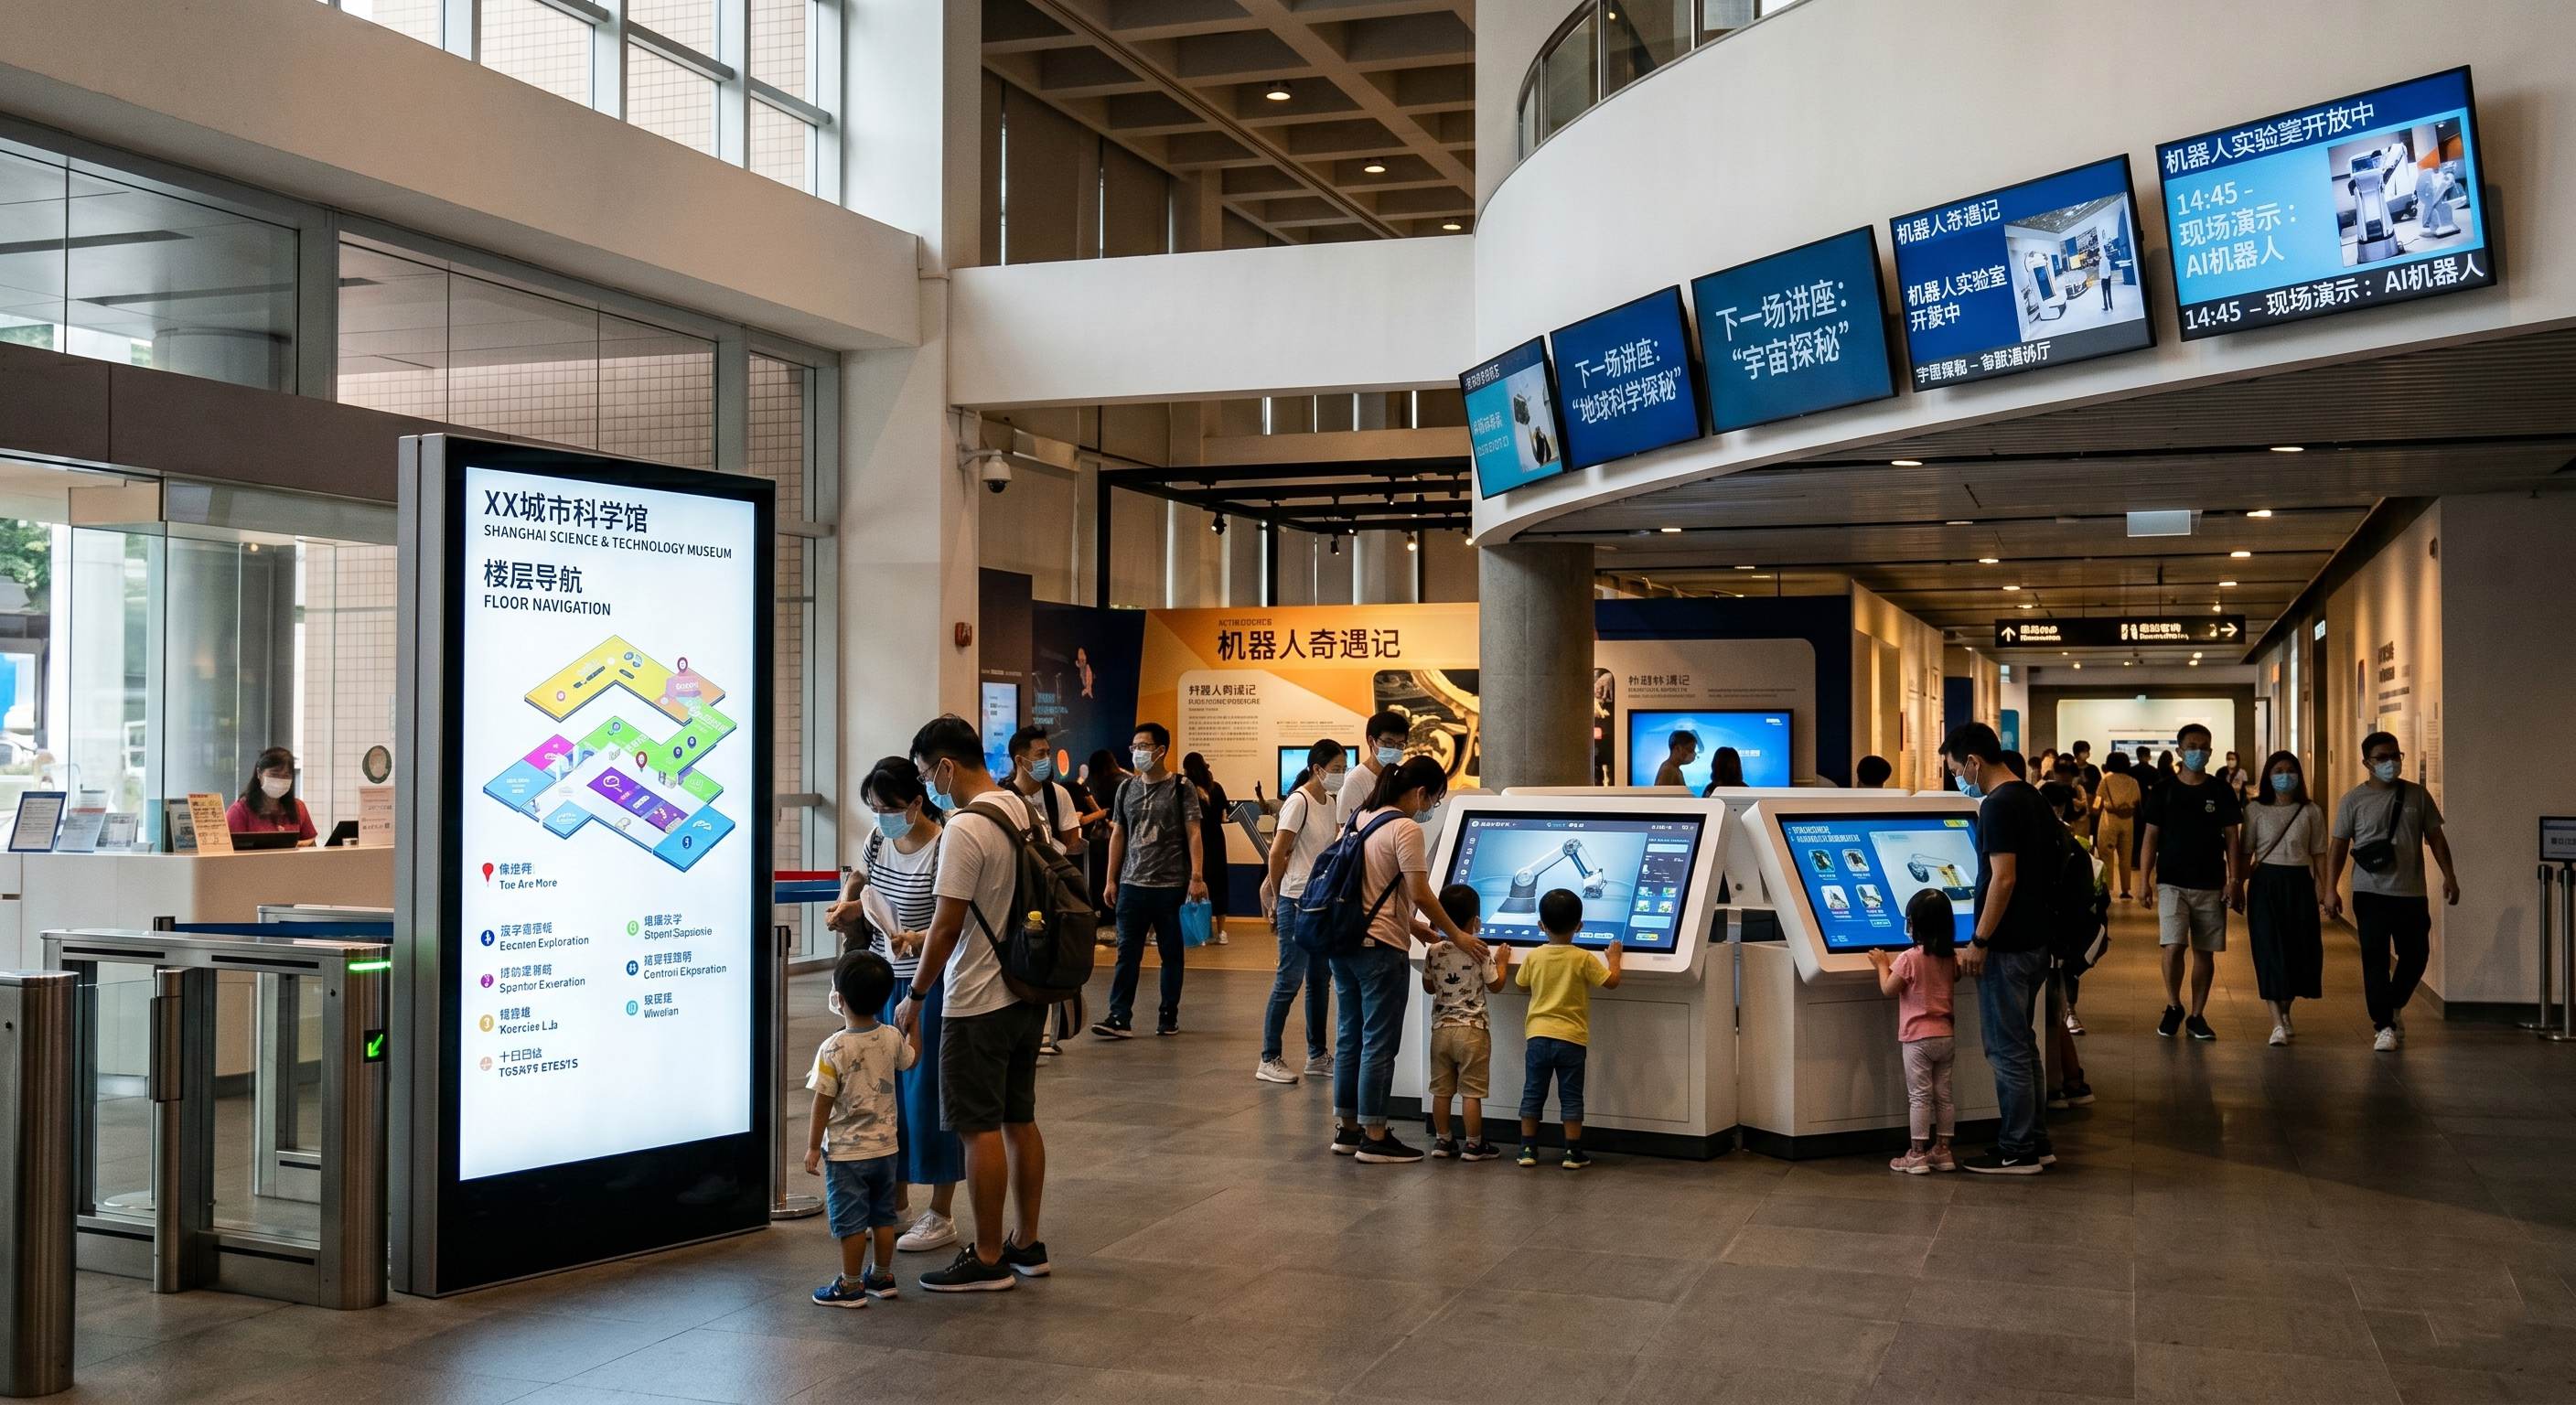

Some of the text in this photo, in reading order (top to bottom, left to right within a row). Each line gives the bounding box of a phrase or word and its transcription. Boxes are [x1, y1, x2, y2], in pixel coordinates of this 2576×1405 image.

[2177, 181, 2238, 216] 14:45
[2179, 202, 2297, 247] 现场演示：
[2186, 235, 2284, 279] AI机器人
[1907, 264, 2008, 306] 机器人实验室
[1715, 279, 1847, 342] 下一场讲座：
[2185, 301, 2242, 330] 14:45
[1574, 337, 1661, 389] 下一场讲座：
[1732, 320, 1849, 381] “宇宙探秘”
[1572, 366, 1681, 424] “地球科学探秘”
[484, 489, 649, 533] XX城市科学馆
[484, 524, 732, 559] SHANGHAI SCIENCE & TECHNOLOGY MUSEUM
[484, 558, 583, 594] 楼层导航
[484, 595, 611, 616] FLOOR NAVIGATION
[1218, 628, 1401, 661] 机器人奇遇记
[518, 879, 533, 888] Are
[536, 878, 557, 887] More
[538, 936, 589, 949] Exploration
